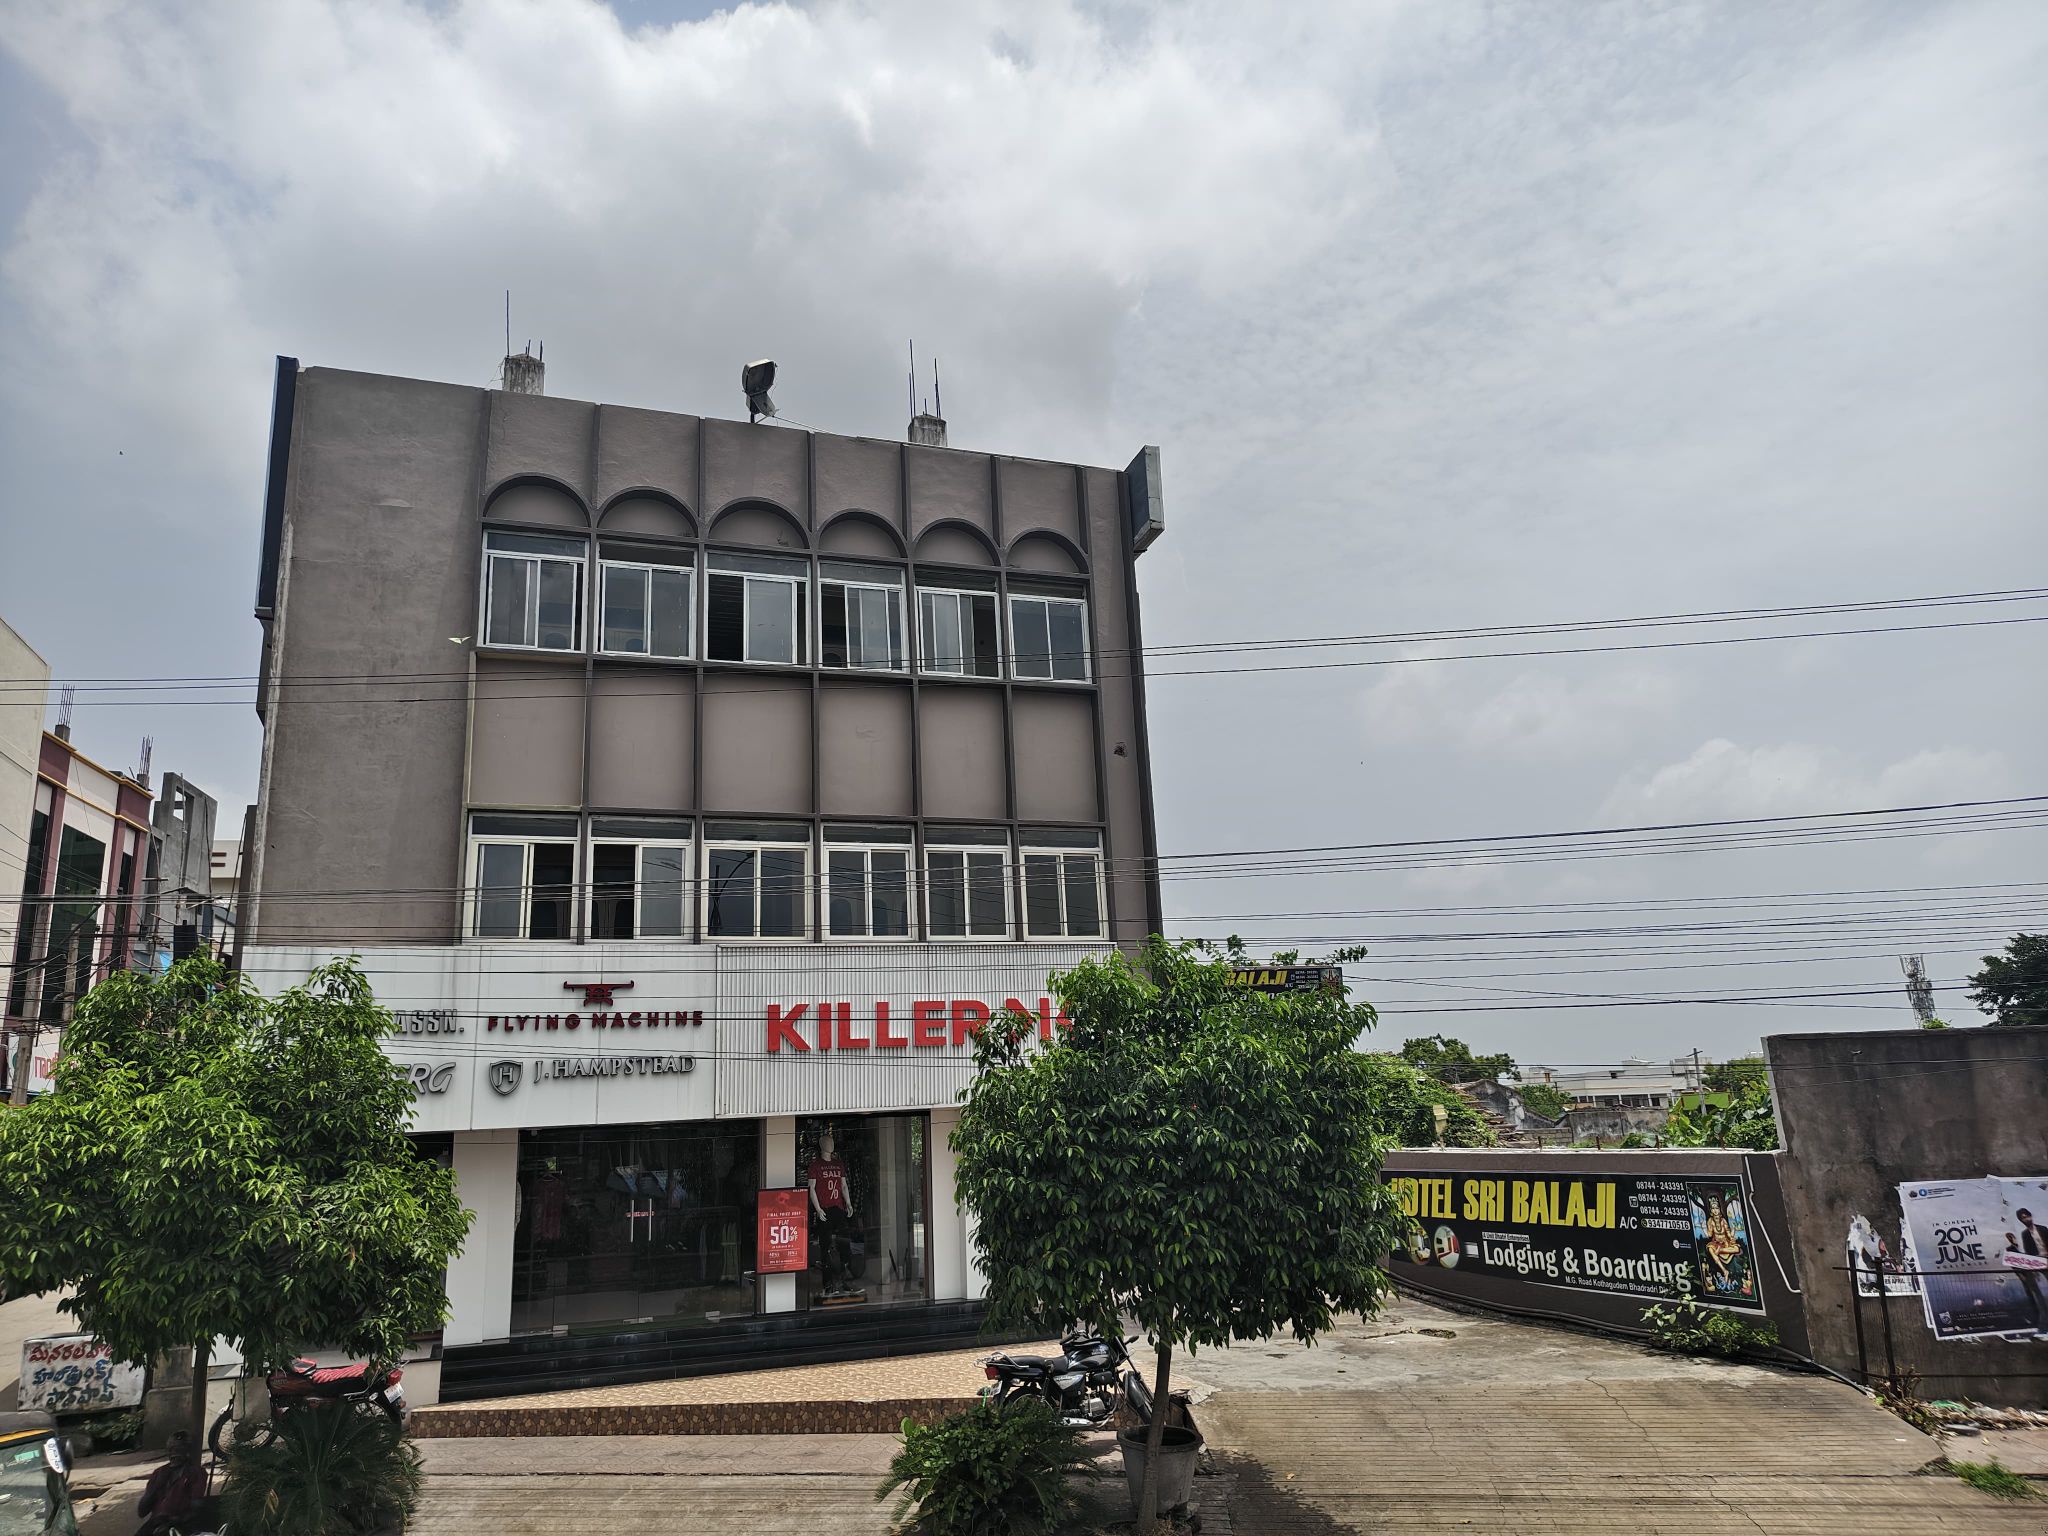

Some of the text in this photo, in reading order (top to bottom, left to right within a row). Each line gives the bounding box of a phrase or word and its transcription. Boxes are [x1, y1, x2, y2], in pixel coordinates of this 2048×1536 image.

[1224, 970, 1288, 985] BALAJI
[487, 1011, 704, 1032] FLYING MACHINE
[1636, 1181, 1656, 1190] 08744
[1660, 1182, 1685, 1191] 243391
[1463, 1179, 1505, 1222] SRI
[1512, 1180, 1617, 1229] BALAJI
[1638, 1193, 1658, 1202] 08744
[1662, 1194, 1687, 1203] 243392
[1640, 1206, 1660, 1215] 08744
[1664, 1207, 1689, 1216] 243393
[1619, 1216, 1638, 1229] A/C
[1648, 1219, 1690, 1230] 9347710516
[1934, 1224, 1978, 1246] 20TH
[1935, 1242, 1986, 1265] JUNE
[1482, 1240, 1692, 1293] Lodging & Boarding
[1565, 1276, 1577, 1284] M.G.
[1578, 1277, 1592, 1286] Road
[1592, 1278, 1629, 1290] Kothagudem
